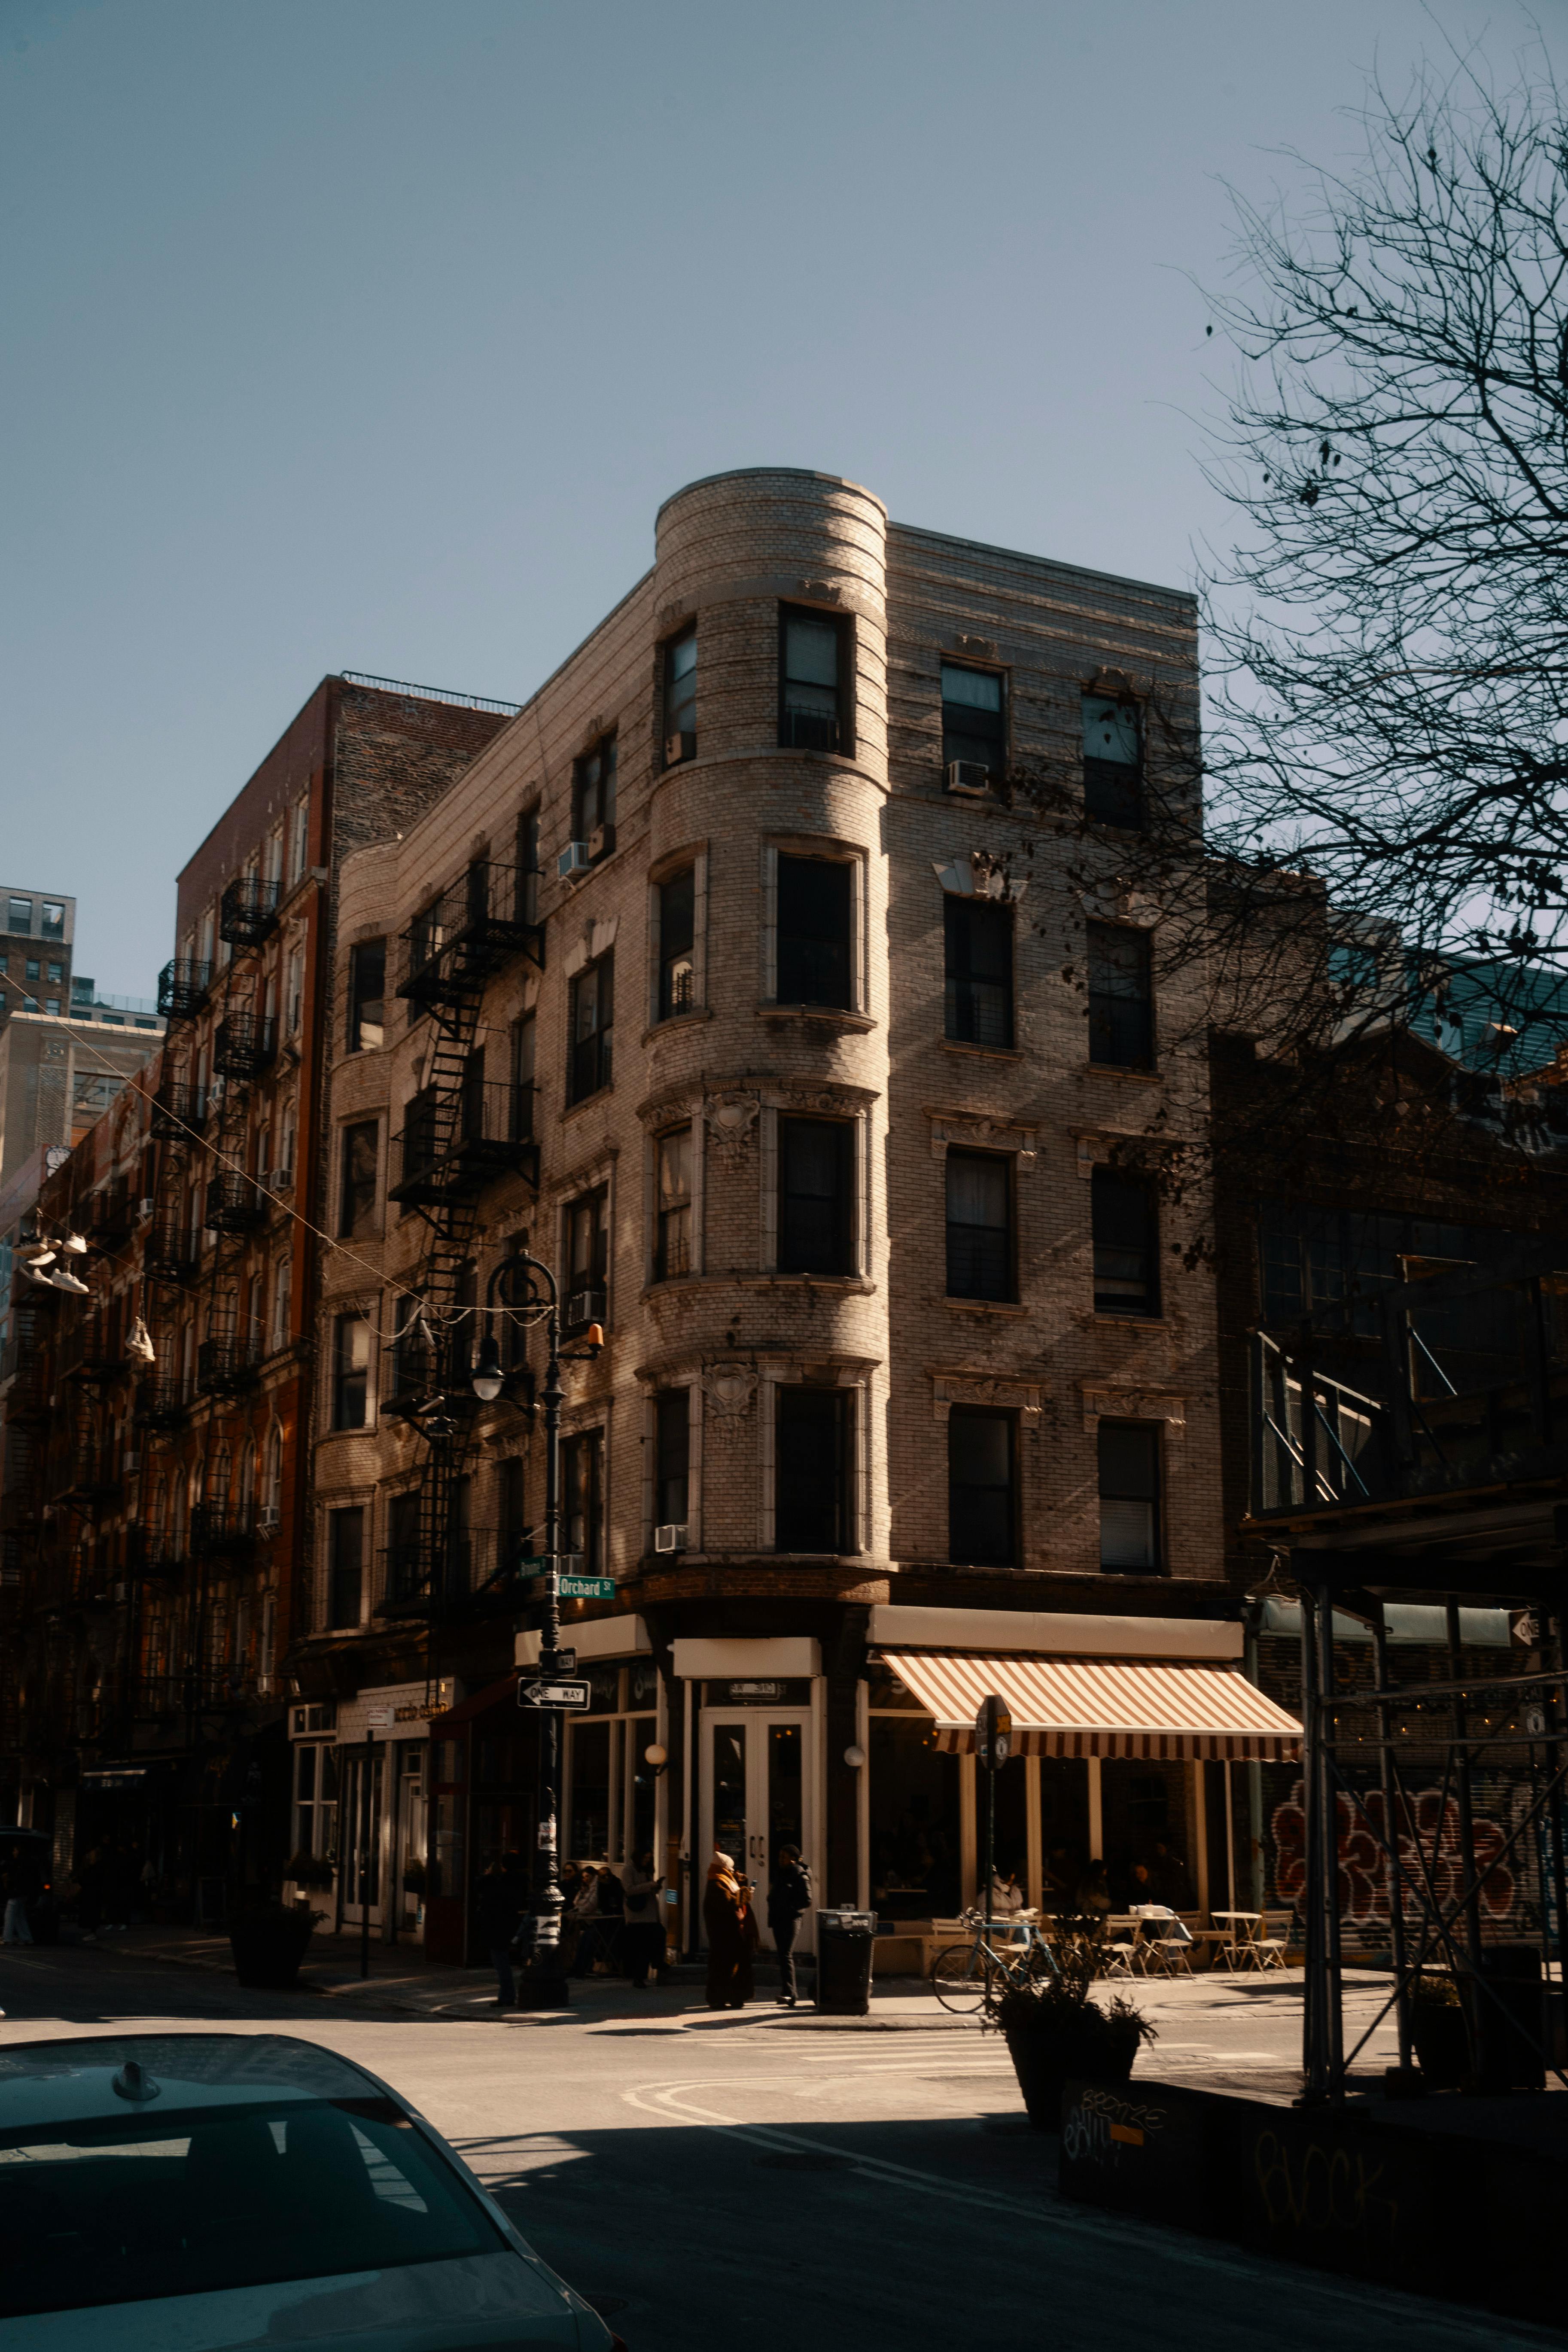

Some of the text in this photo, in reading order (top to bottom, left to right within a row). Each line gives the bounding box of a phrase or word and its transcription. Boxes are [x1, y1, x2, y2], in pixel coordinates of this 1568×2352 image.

[561, 1578, 612, 1596] Orchard St
[1519, 1622, 1540, 1636] ONE
[530, 1687, 582, 1700] ONE WAY
